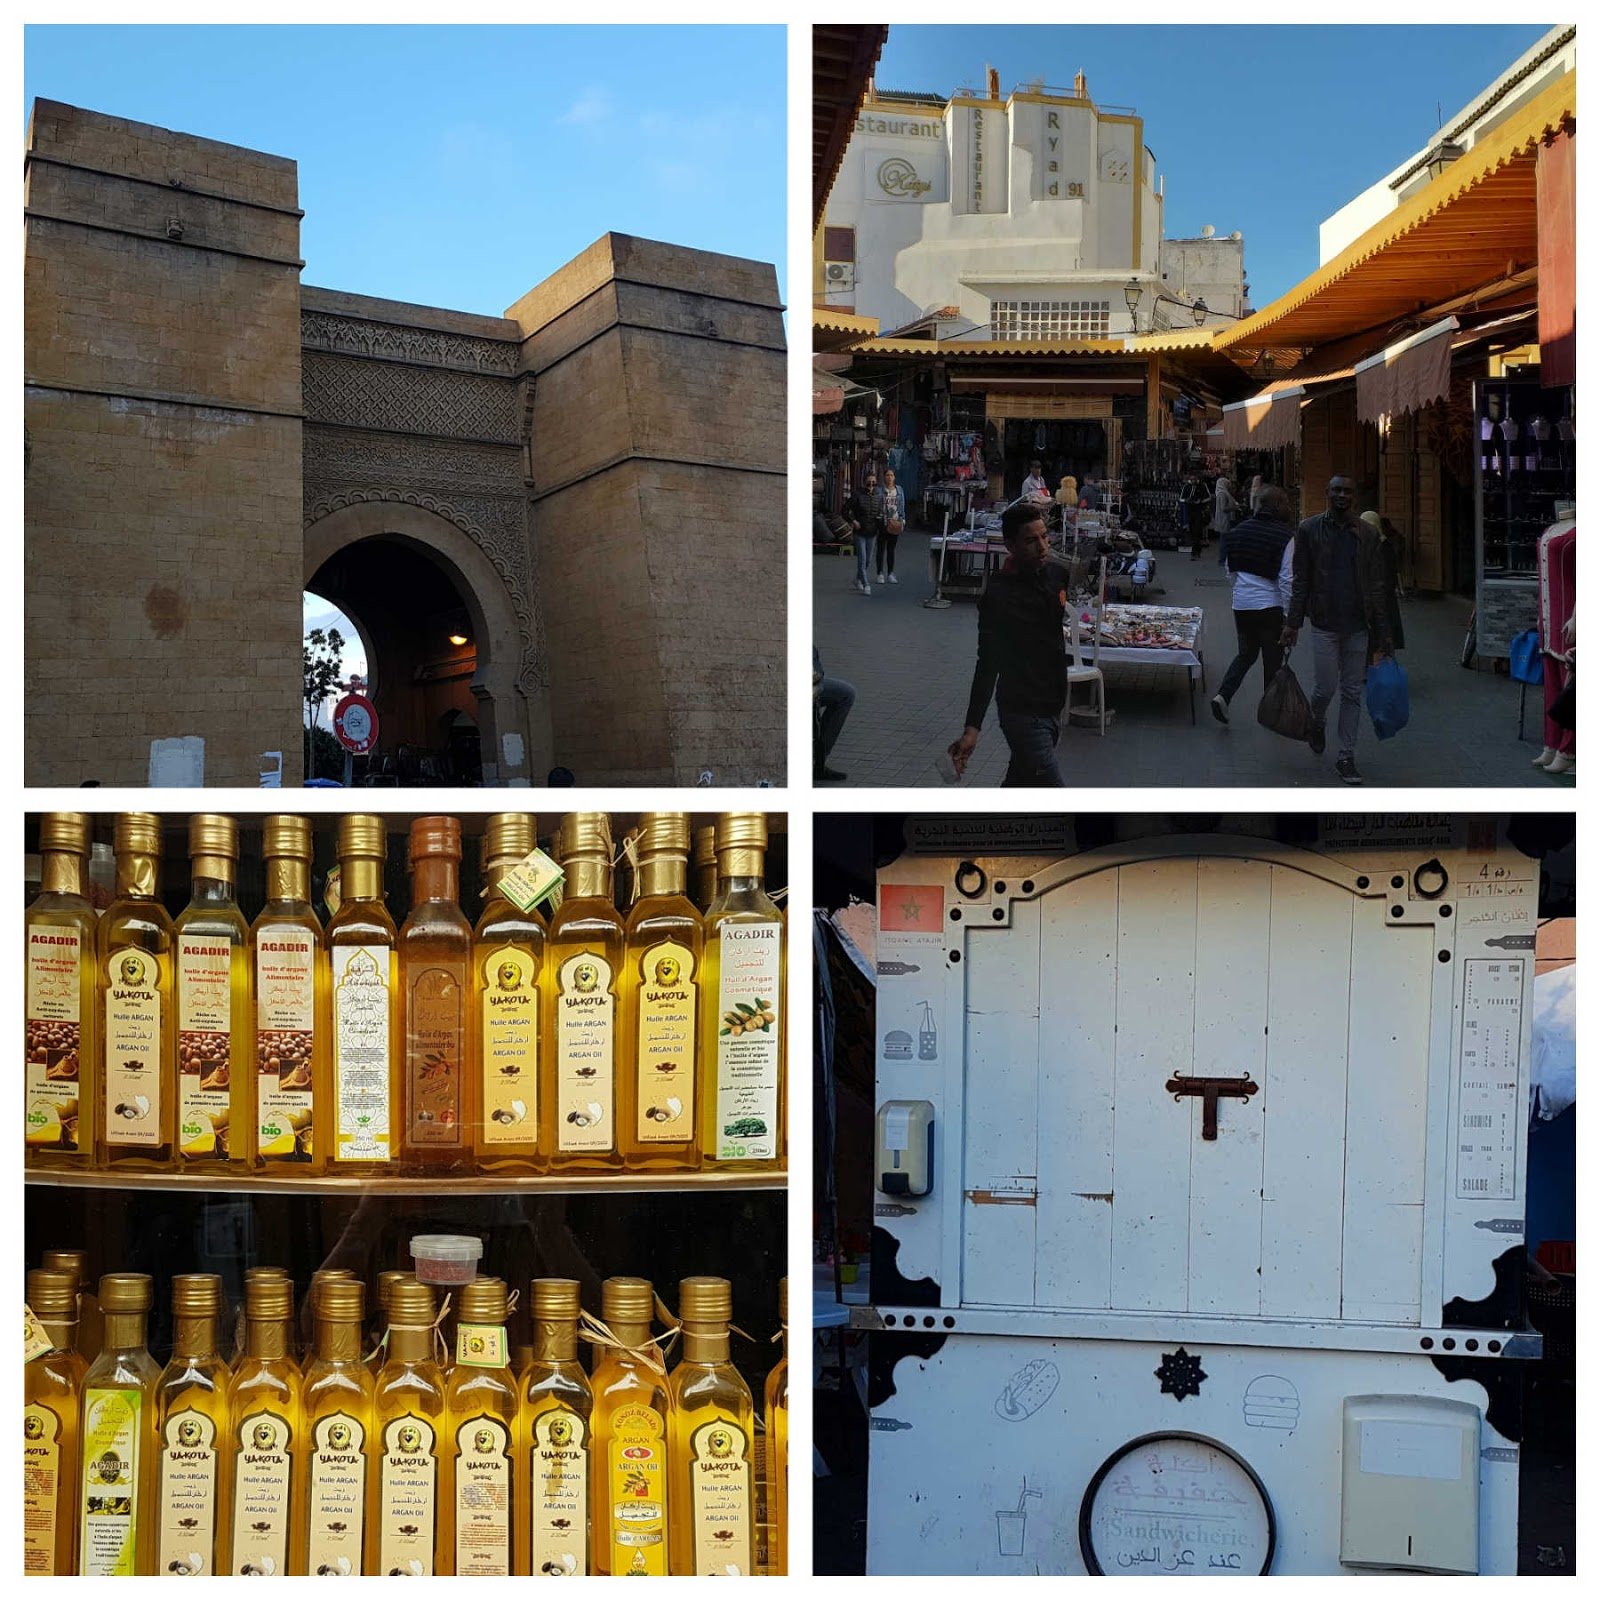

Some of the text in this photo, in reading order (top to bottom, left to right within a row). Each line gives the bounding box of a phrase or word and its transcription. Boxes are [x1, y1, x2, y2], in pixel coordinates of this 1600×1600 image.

[1047, 111, 1060, 196] Ryad
[1068, 182, 1085, 197] 91
[1479, 863, 1488, 879] 4
[725, 929, 776, 940] AGADIR
[31, 935, 78, 946] AGADIR
[183, 946, 229, 956] AGADIR
[260, 943, 308, 952] AGADIR
[623, 1436, 650, 1444] ARGAN
[90, 1461, 130, 1469] AGADIR
[618, 1463, 645, 1471] ARGAN
[1109, 1519, 1248, 1546] Sandwicherie
[1117, 1545, 1241, 1571] عند عز الدين
